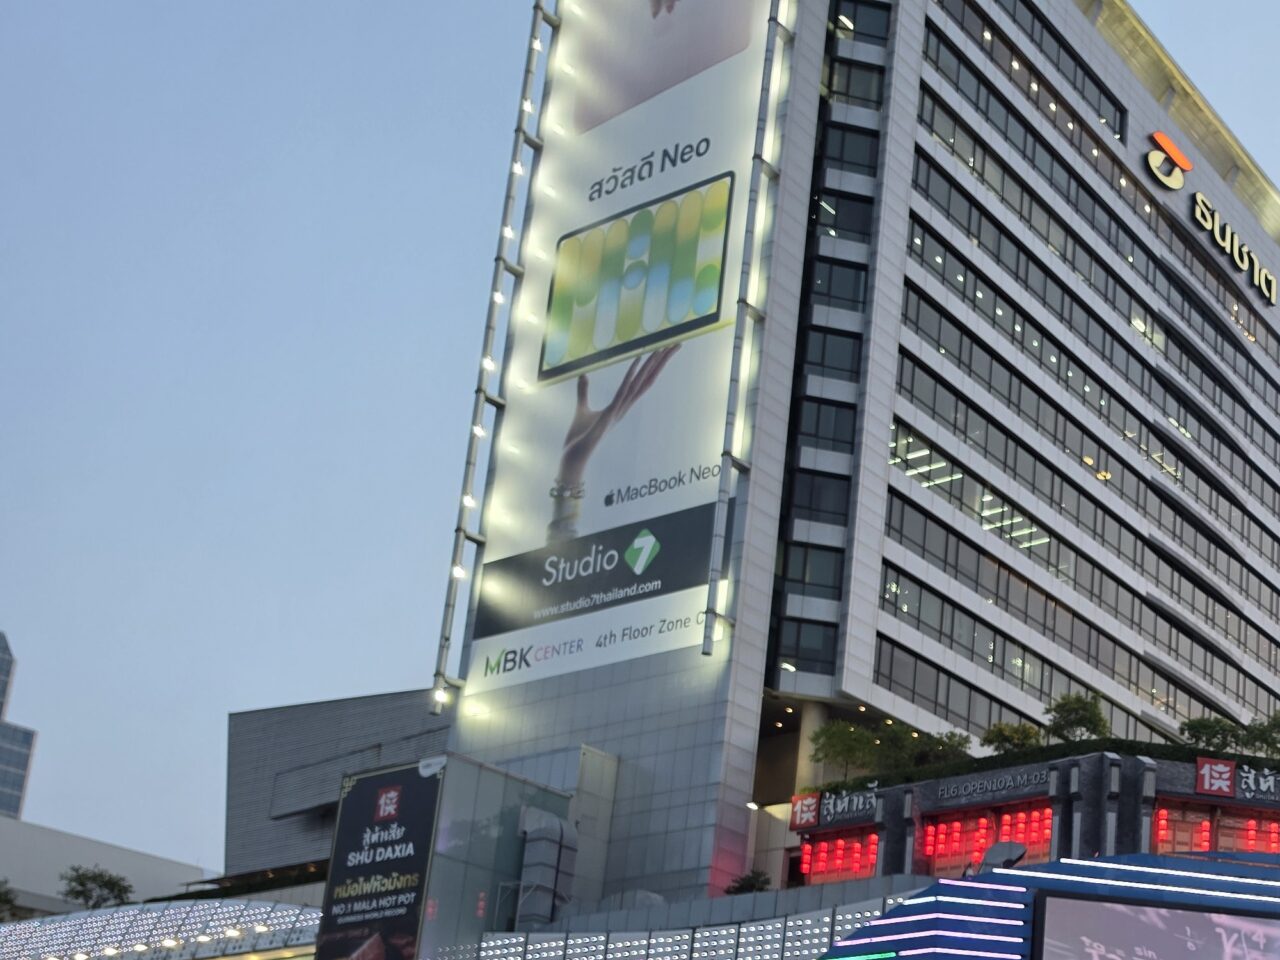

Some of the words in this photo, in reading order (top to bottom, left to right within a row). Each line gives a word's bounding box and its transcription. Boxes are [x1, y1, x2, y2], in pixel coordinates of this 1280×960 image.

[588, 151, 655, 201] สวัสดี
[660, 137, 711, 173] Neo
[1194, 191, 1277, 305] ธนชาต
[616, 470, 686, 505] MacBook
[689, 464, 721, 484] Neo
[542, 543, 619, 587] Studio
[533, 578, 662, 620] www.studio7thailand.com
[595, 633, 617, 648] 4th
[621, 621, 655, 643] Floor
[658, 616, 692, 634] Zone
[484, 643, 533, 678] MBK
[534, 638, 584, 662] CENTER
[347, 848, 374, 867] SHU
[375, 842, 414, 862] DAXIA
